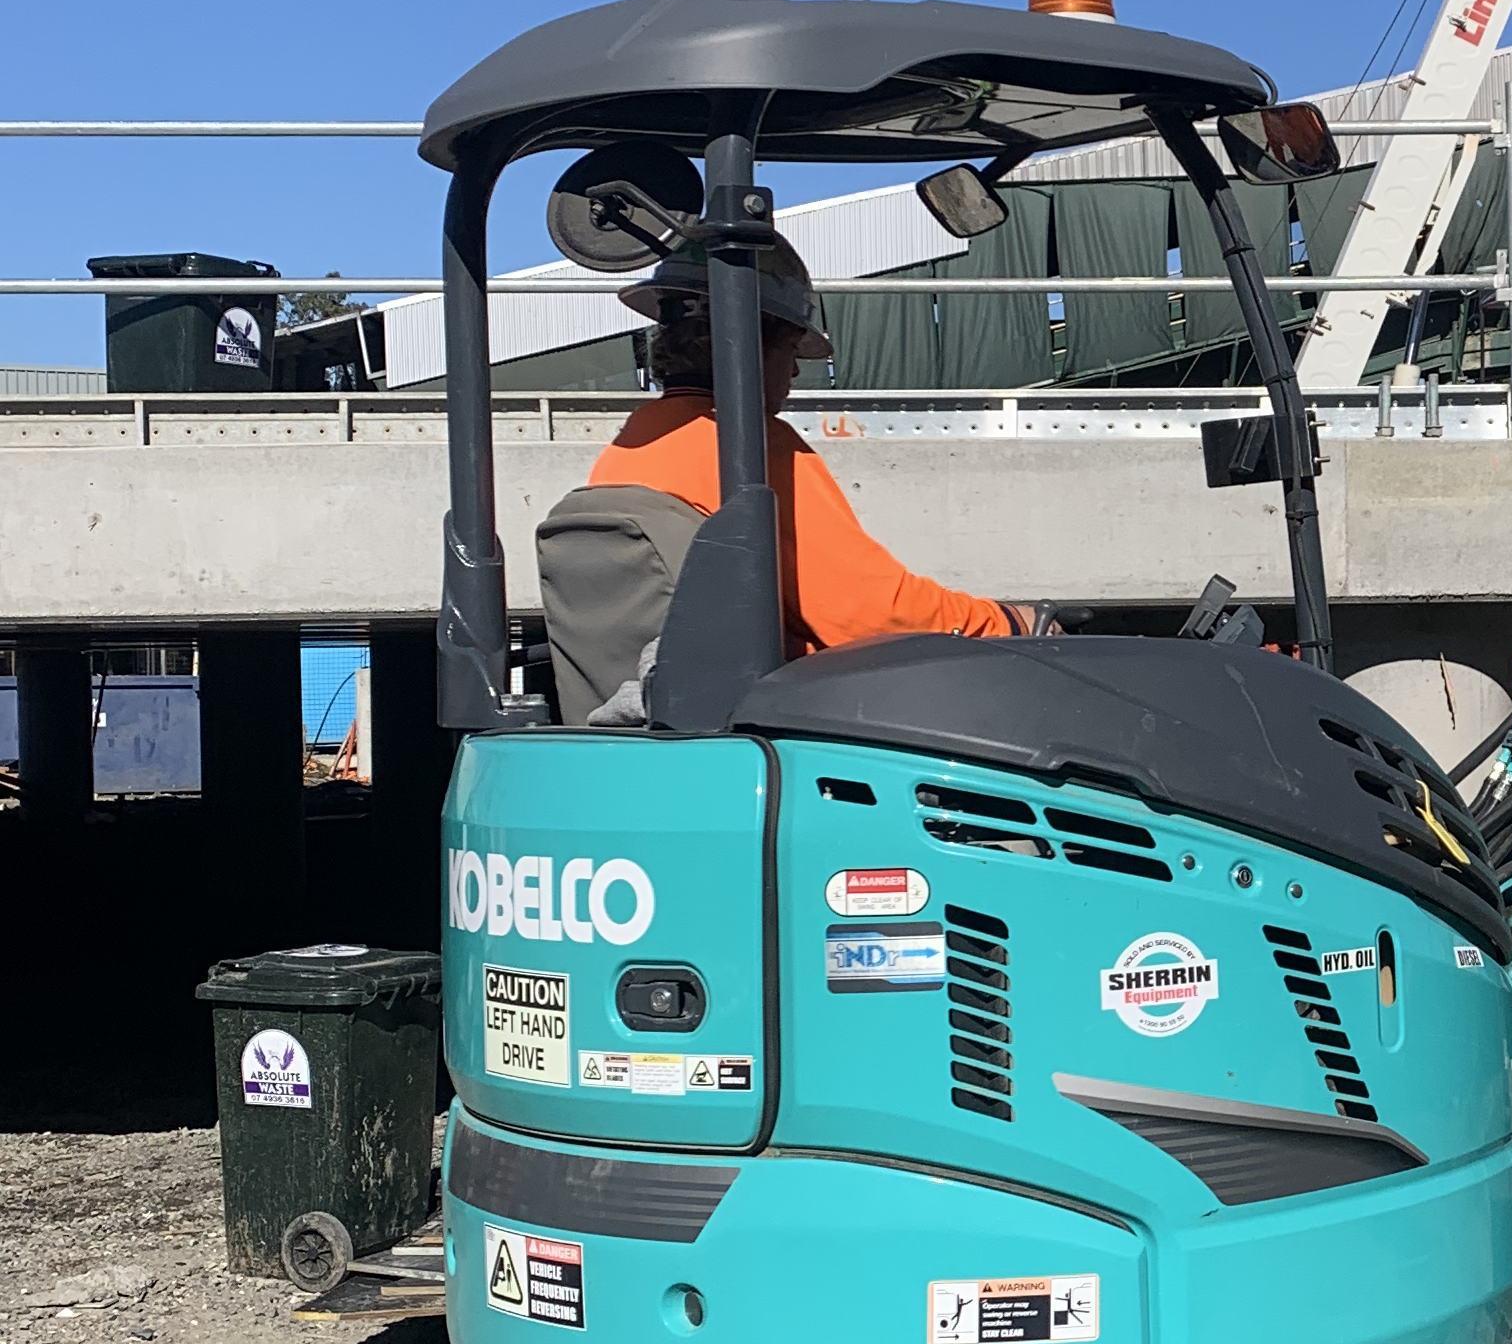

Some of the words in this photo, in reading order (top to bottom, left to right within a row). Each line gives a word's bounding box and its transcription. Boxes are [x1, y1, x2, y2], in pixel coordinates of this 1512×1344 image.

[859, 876, 906, 886] DANGER
[449, 848, 655, 945] KOBELCO
[1324, 953, 1353, 972] HYD.
[1355, 949, 1374, 967] OIL
[1457, 949, 1482, 966] DIESEL
[1109, 965, 1211, 991] SHERRIN
[486, 972, 564, 1007] CAUTION
[1124, 984, 1198, 1005] Equipment
[486, 1006, 516, 1033] LEFT
[520, 1012, 566, 1040] HAND
[503, 1042, 545, 1071] DRIVE
[251, 1071, 301, 1083] ABSOLUTE
[258, 1082, 295, 1095] WASTE
[539, 1243, 578, 1261] DANGER
[529, 1260, 562, 1281] VEHICLE
[530, 1280, 580, 1303] FREQUENTLY
[998, 1282, 1045, 1292] WARNING
[531, 1299, 577, 1322] REVERSING
